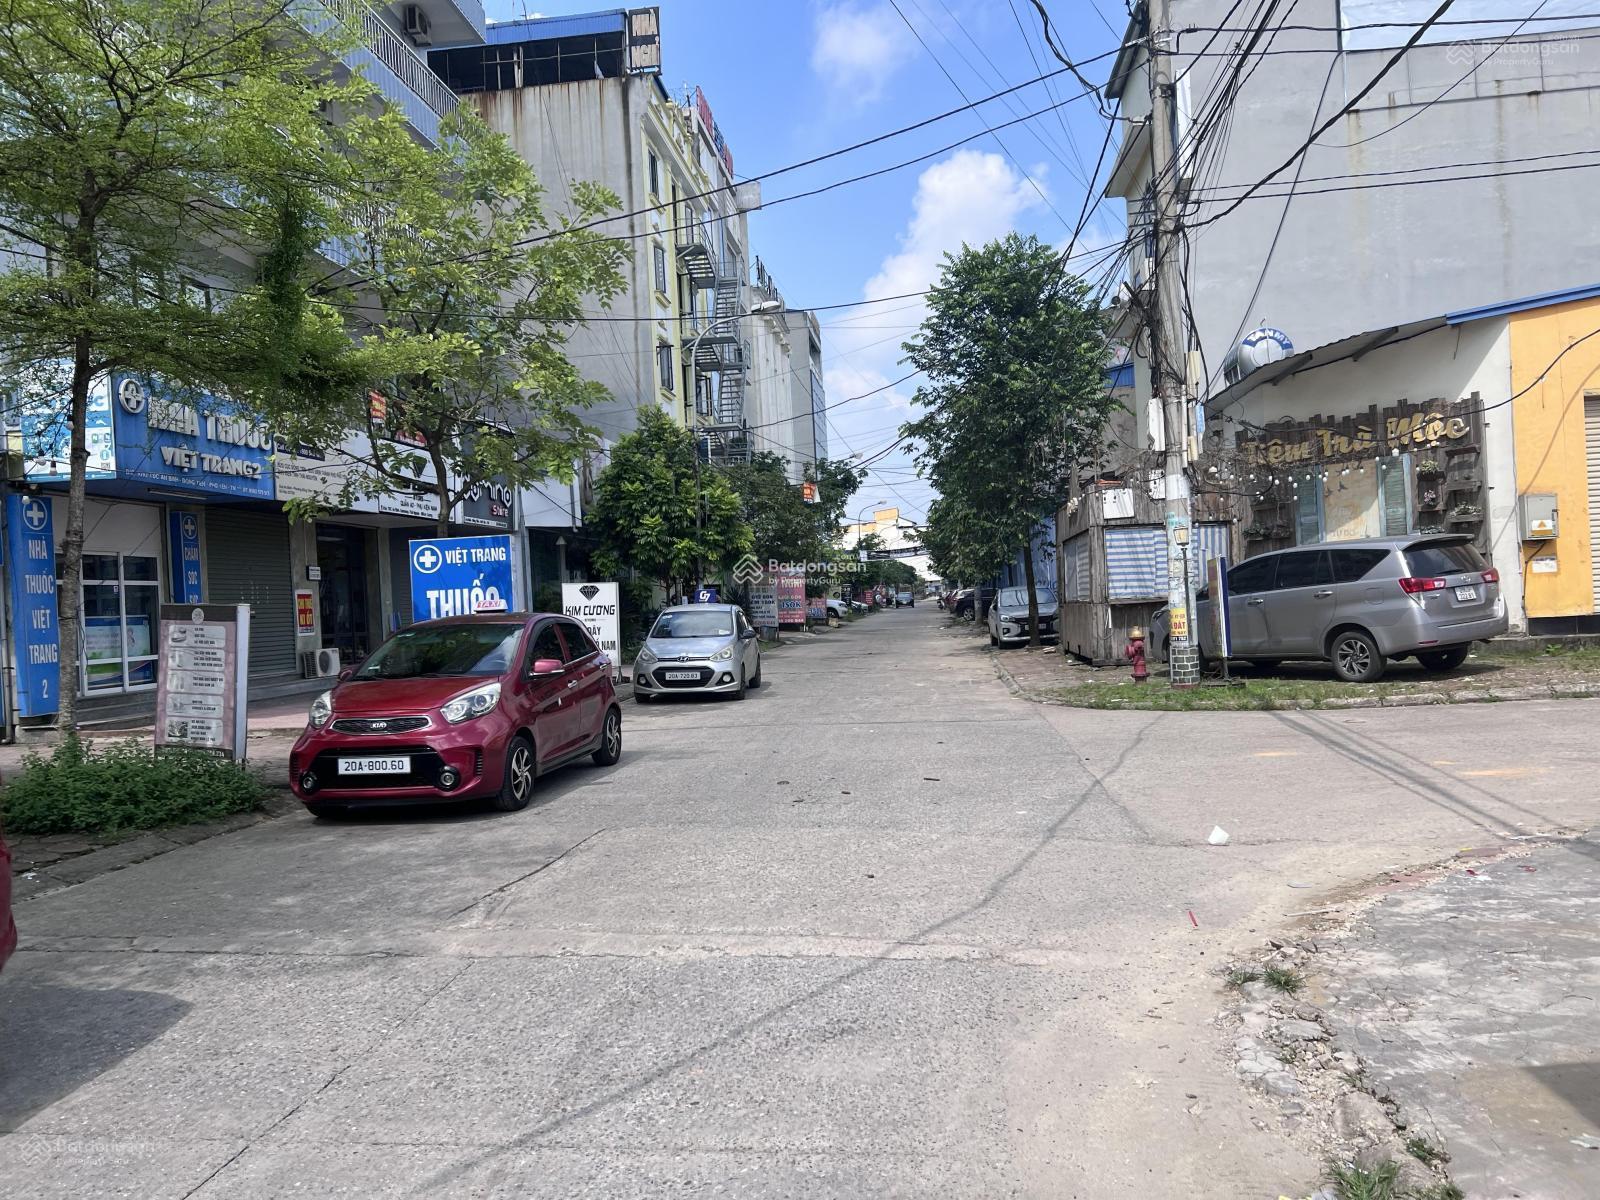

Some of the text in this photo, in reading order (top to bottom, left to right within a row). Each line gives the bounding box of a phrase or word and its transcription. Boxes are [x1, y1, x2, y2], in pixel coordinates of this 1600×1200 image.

[29, 536, 48, 560] NHÀ
[445, 546, 507, 567] VIỆT TRANG
[25, 568, 54, 594] THUỐC
[32, 606, 51, 633] VIỆT
[565, 605, 581, 616] KIM
[29, 643, 58, 665] TRANG
[601, 640, 616, 651] NAM
[42, 679, 49, 699] 2
[344, 760, 405, 772] 20A-800.60
